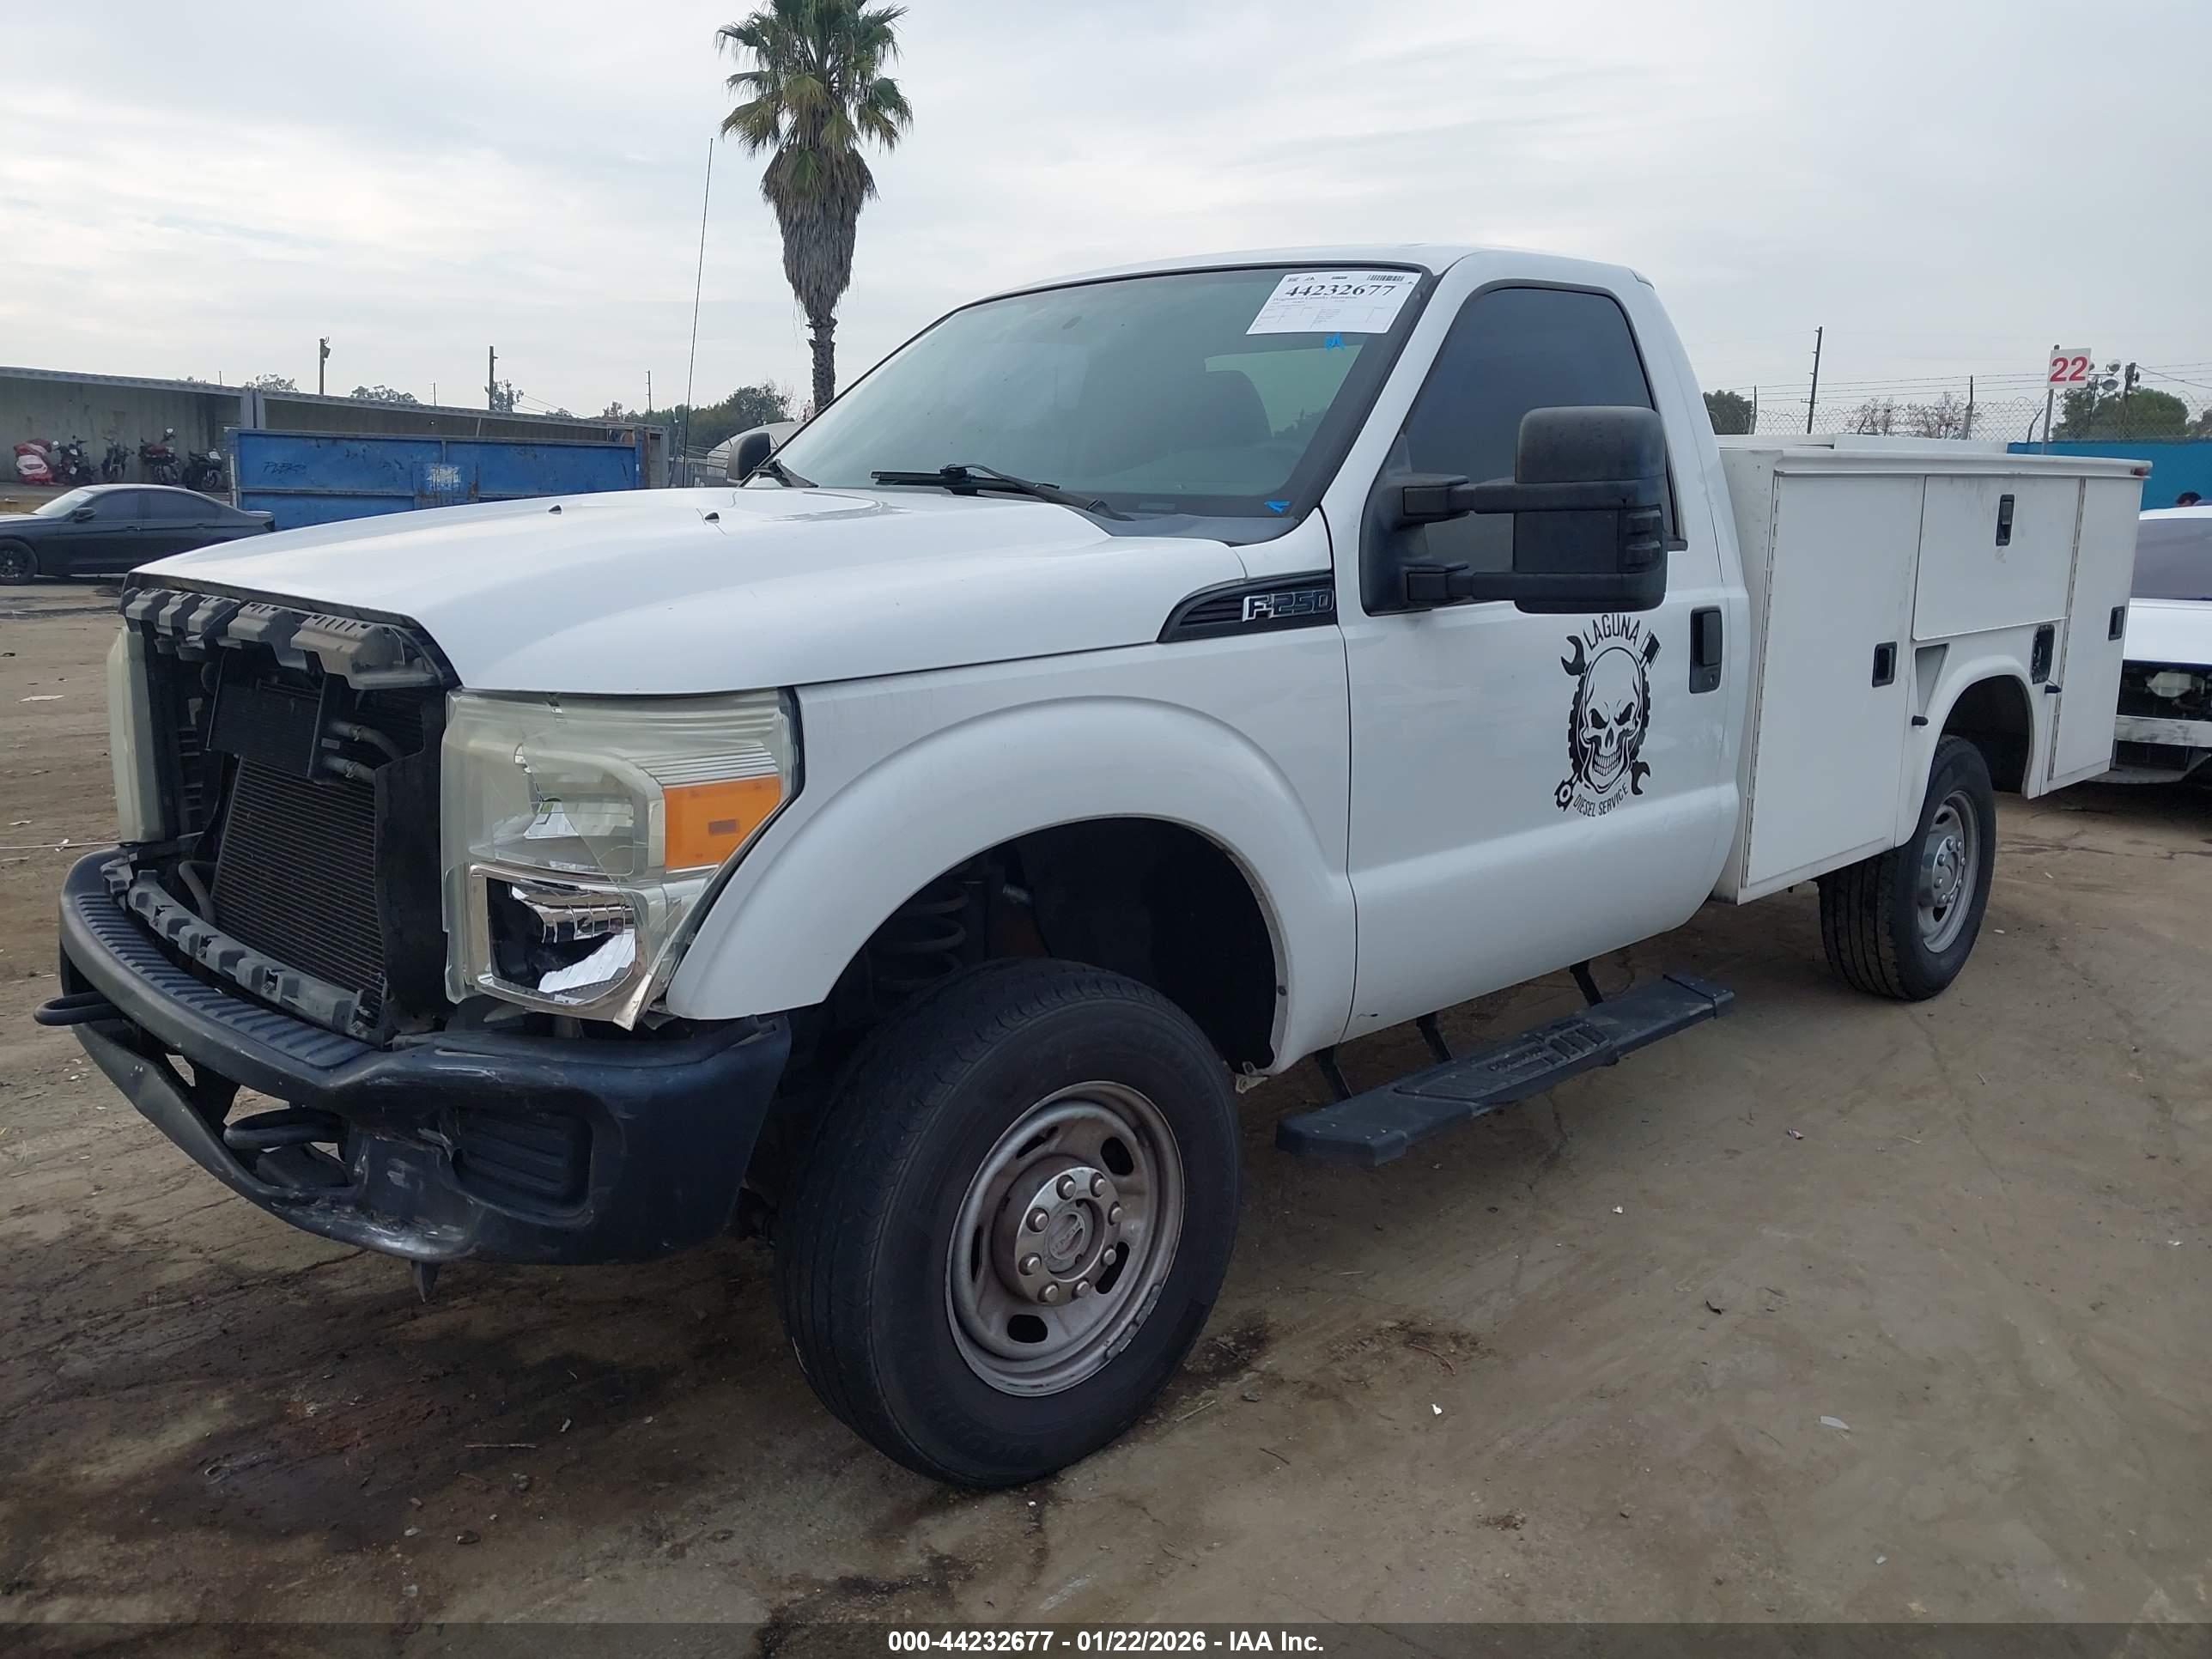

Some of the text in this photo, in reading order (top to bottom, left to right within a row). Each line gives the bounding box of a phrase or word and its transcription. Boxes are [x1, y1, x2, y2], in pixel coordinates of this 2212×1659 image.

[1285, 284, 1397, 296] 44232677
[2050, 356, 2088, 382] 22
[1583, 613, 1641, 651] LAGUNA
[1573, 782, 1629, 817] DIESEL SERVICE
